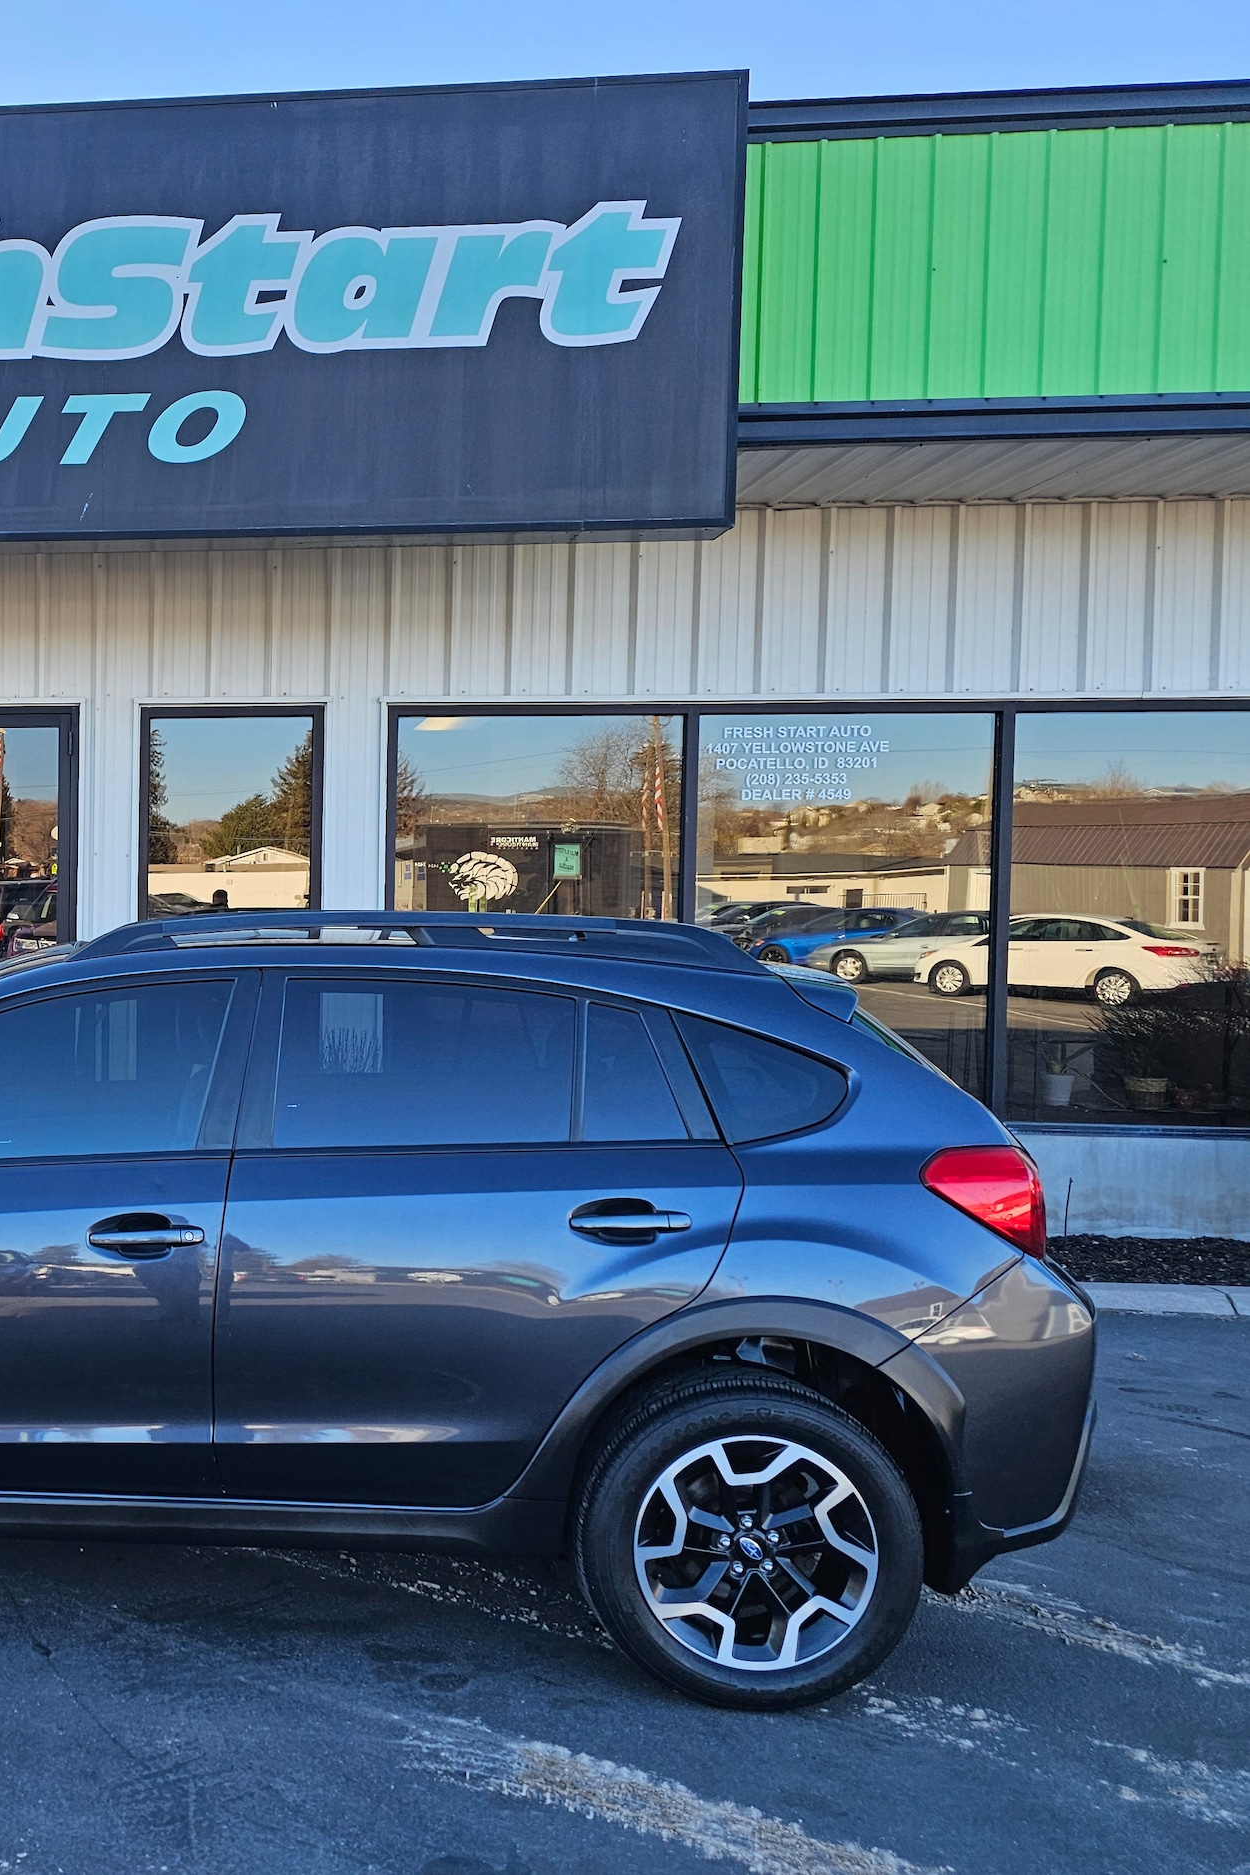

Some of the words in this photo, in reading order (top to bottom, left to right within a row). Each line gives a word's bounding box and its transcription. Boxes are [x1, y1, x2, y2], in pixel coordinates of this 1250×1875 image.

[724, 727, 773, 739] FRESH
[777, 726, 826, 738] START
[829, 725, 872, 737] AUTO
[707, 743, 738, 755] 1407
[742, 741, 856, 754] YELLOWSTONE
[859, 741, 889, 753] AVE
[716, 757, 809, 771] POCATELLO,
[814, 758, 829, 769] ID
[837, 757, 878, 769] 83201
[746, 774, 781, 787] (208)
[784, 773, 847, 785] 235-5353
[741, 789, 802, 801] DEALER
[805, 789, 815, 800] #
[818, 788, 852, 800] 4549
